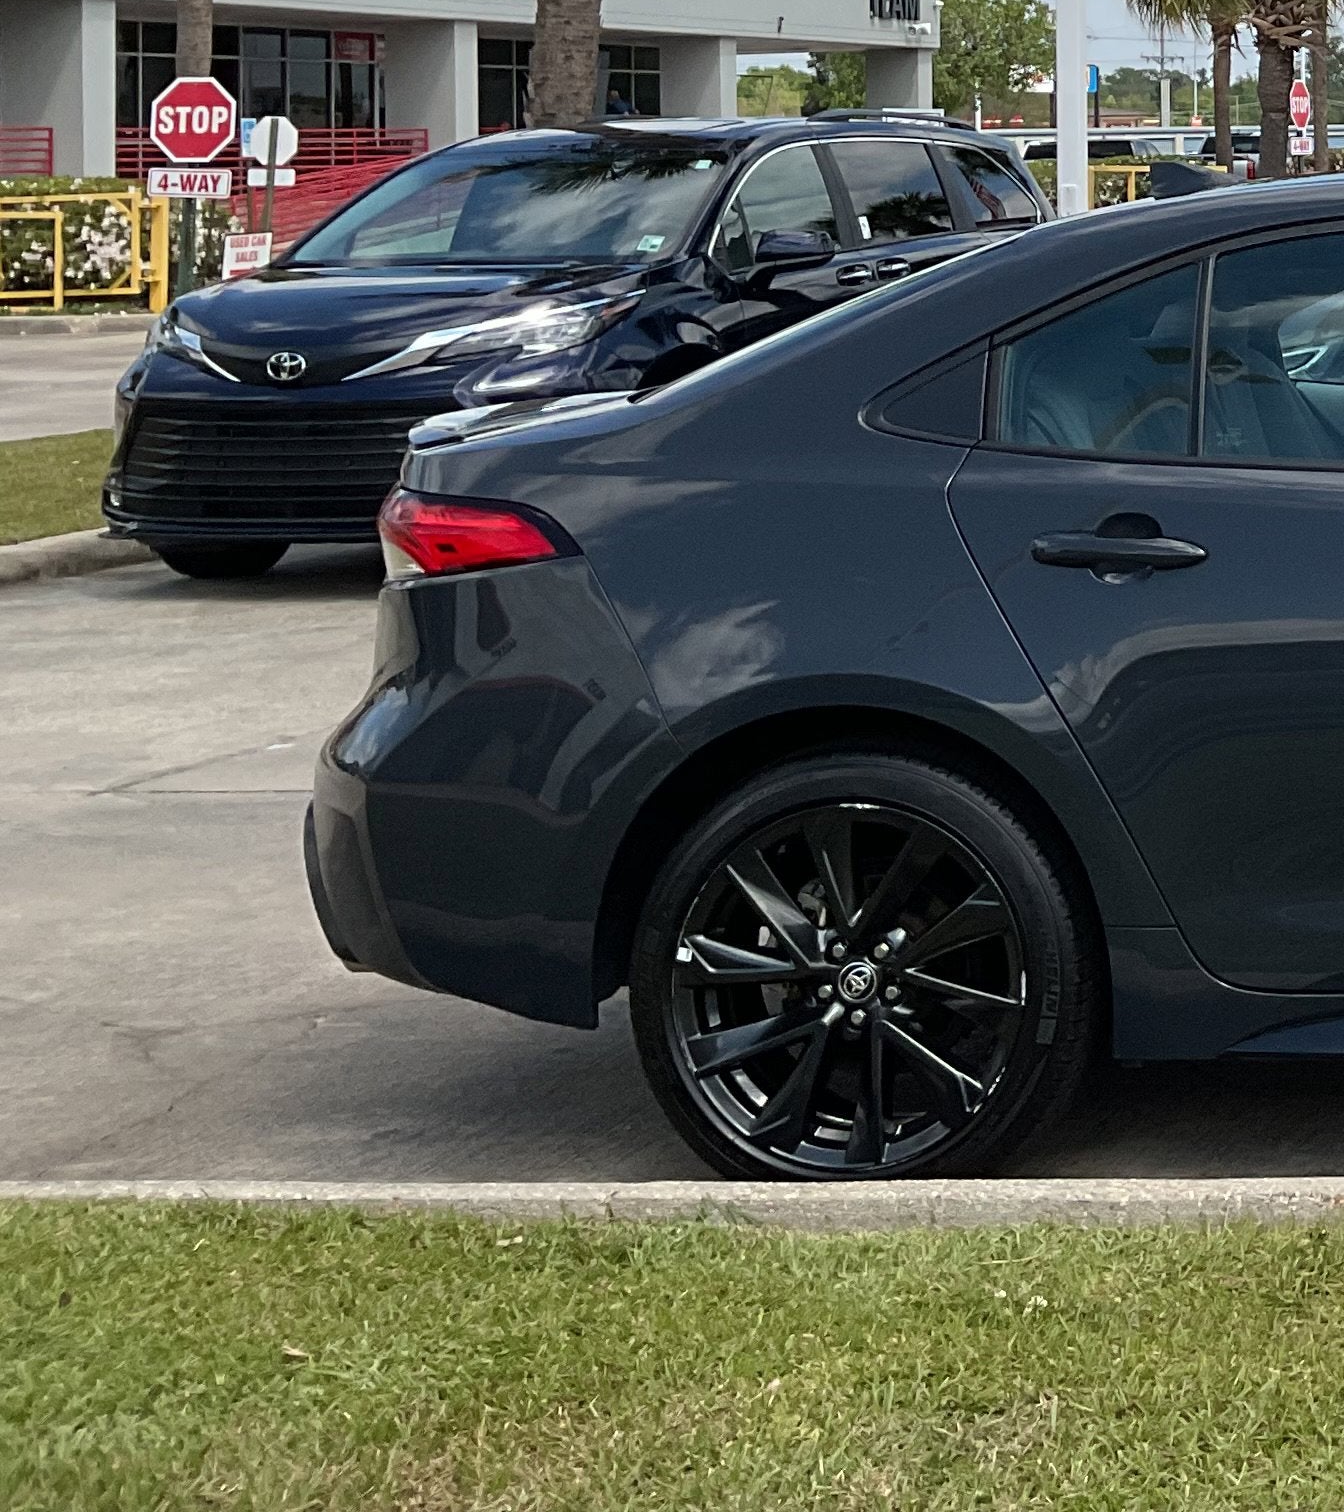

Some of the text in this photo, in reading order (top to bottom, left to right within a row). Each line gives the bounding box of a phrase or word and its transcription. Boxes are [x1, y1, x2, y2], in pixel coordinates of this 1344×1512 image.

[1291, 96, 1309, 114] STOP
[158, 105, 229, 135] STOP
[157, 173, 221, 193] 4-WAY
